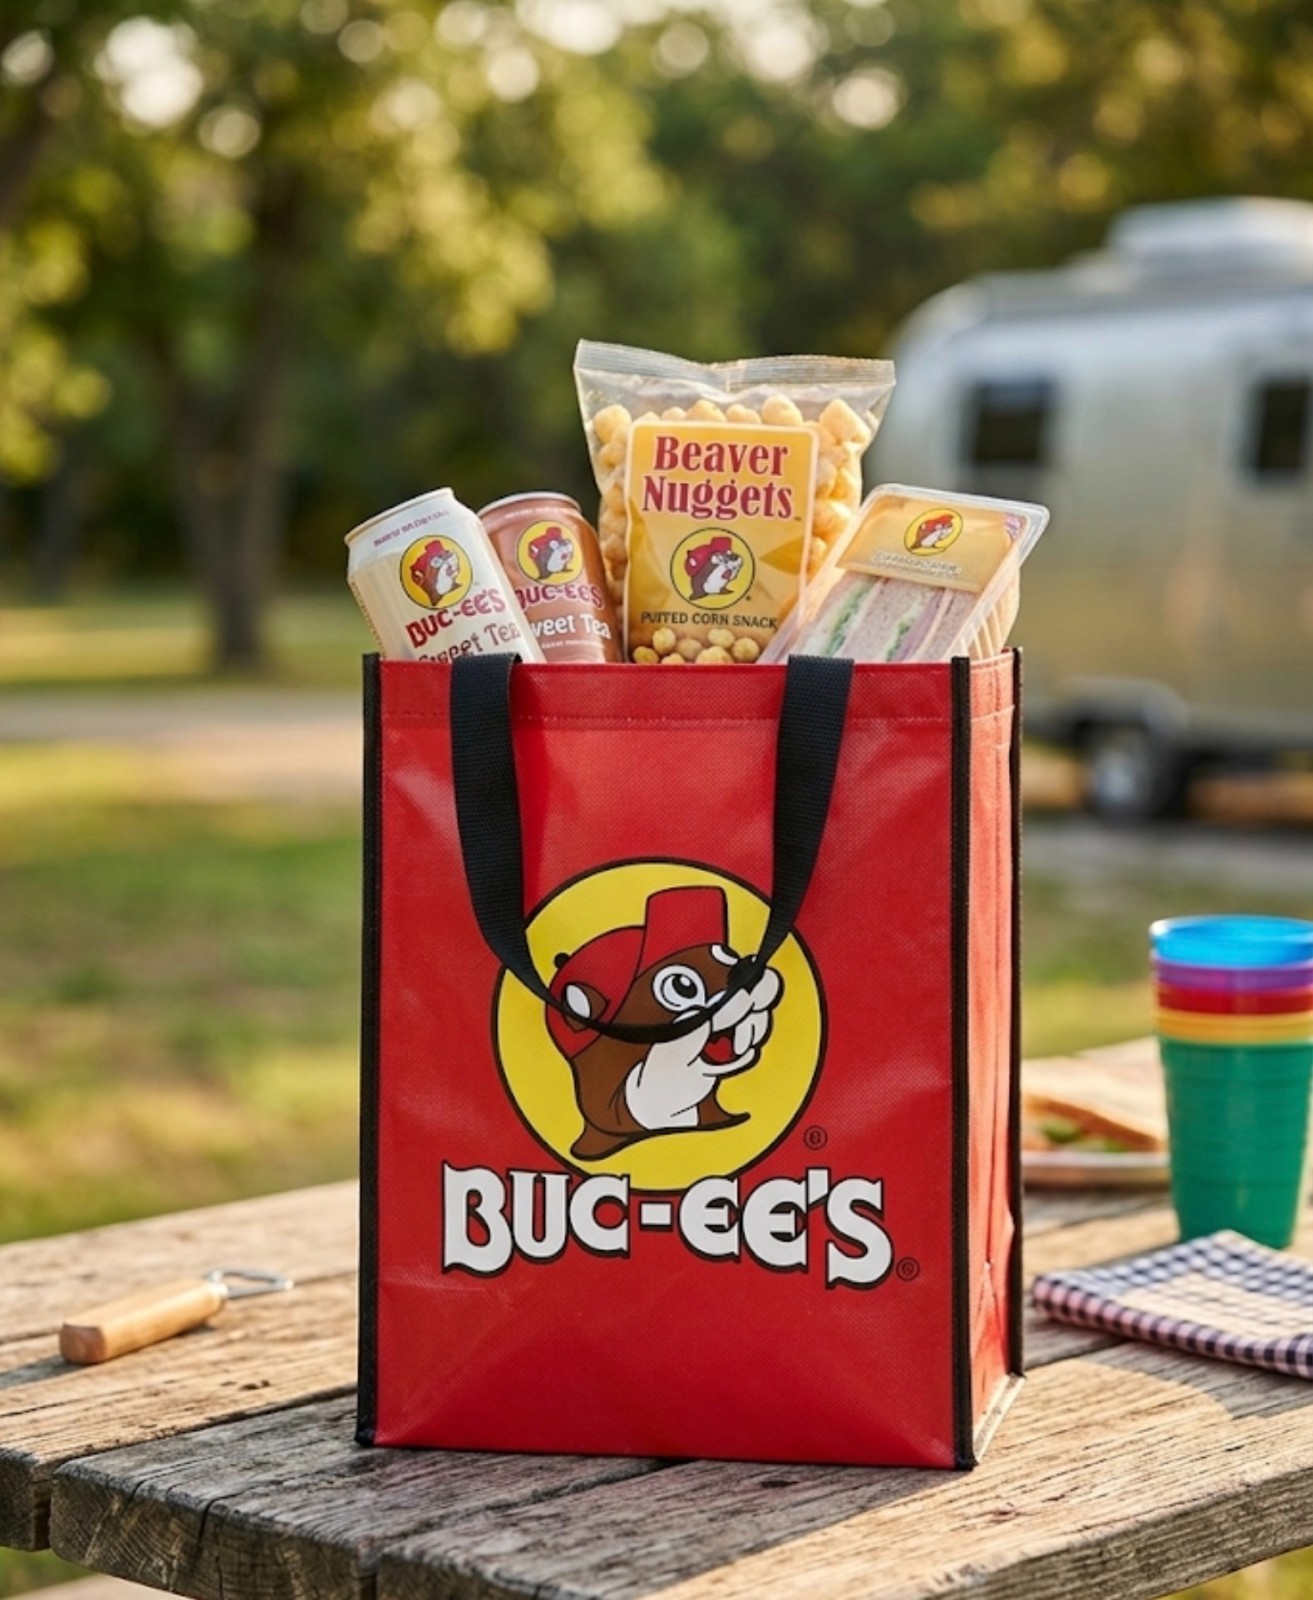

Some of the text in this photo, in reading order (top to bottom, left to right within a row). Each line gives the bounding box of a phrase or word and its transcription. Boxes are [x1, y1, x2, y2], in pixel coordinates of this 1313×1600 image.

[653, 435, 788, 477] Beaver
[641, 475, 793, 520] Nuggets
[530, 613, 612, 640] weet Tea
[692, 612, 729, 626] CORN
[733, 614, 778, 632] SNACK
[442, 1160, 895, 1290] BUC-EE'S
